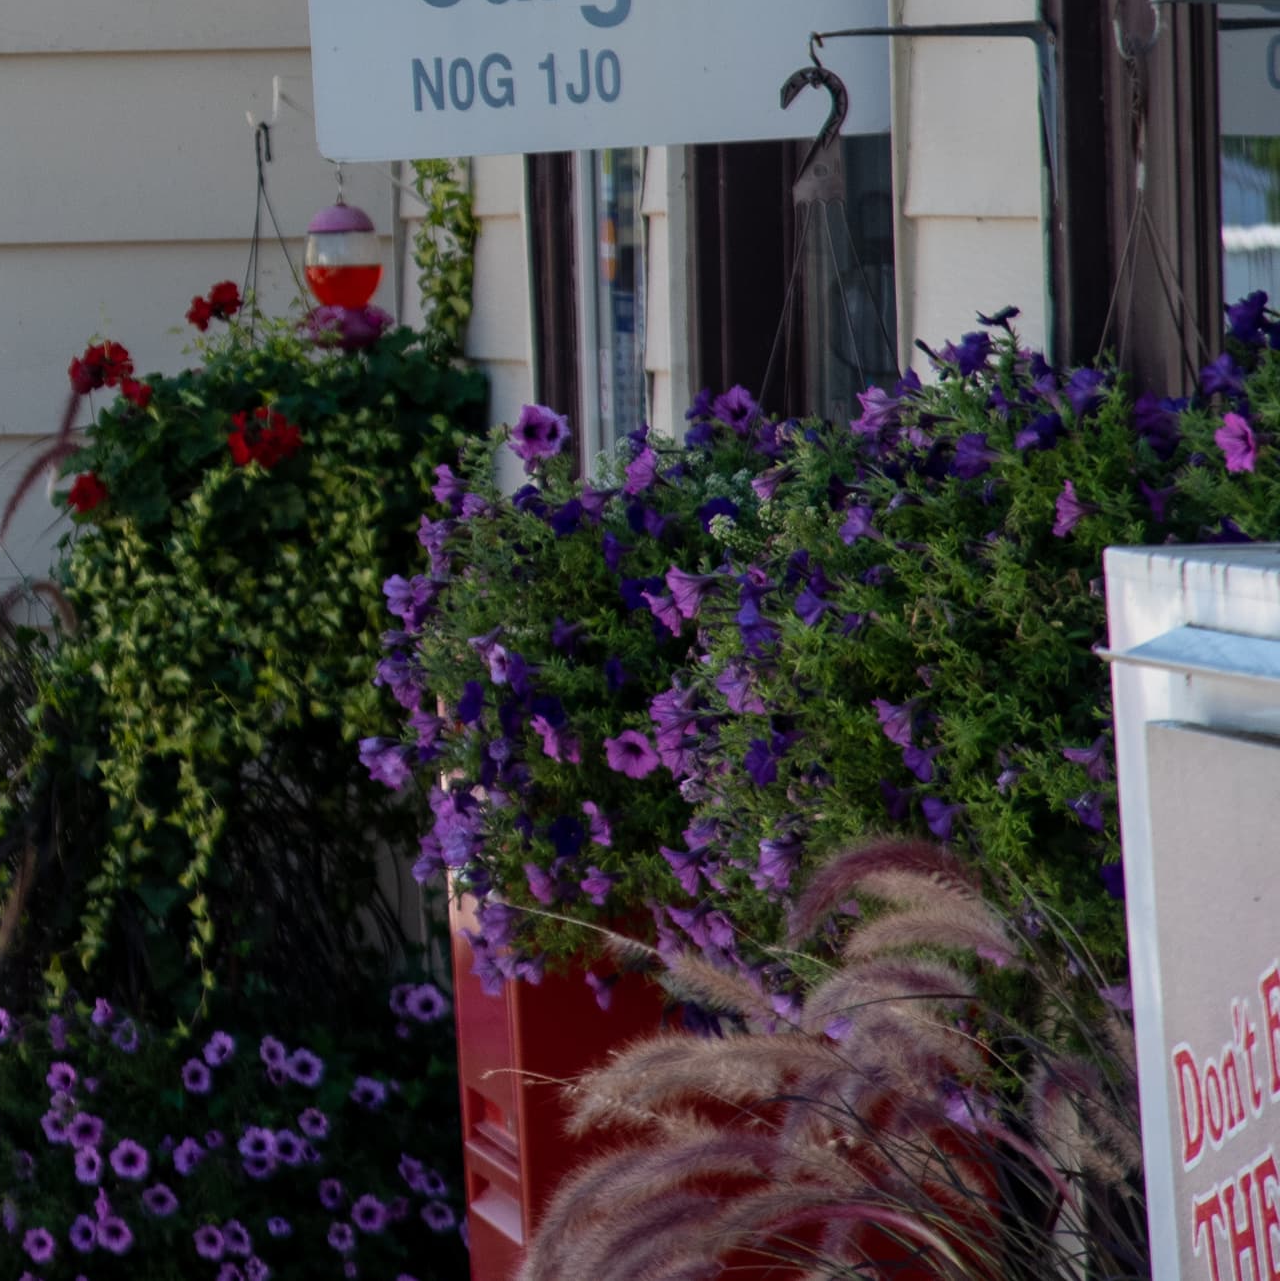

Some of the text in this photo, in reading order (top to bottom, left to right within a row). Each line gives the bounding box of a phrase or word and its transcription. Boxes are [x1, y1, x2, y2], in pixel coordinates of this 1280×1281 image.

[538, 49, 623, 106] 1J0
[1172, 998, 1262, 1170] Don't
[1192, 1151, 1280, 1281] THE
